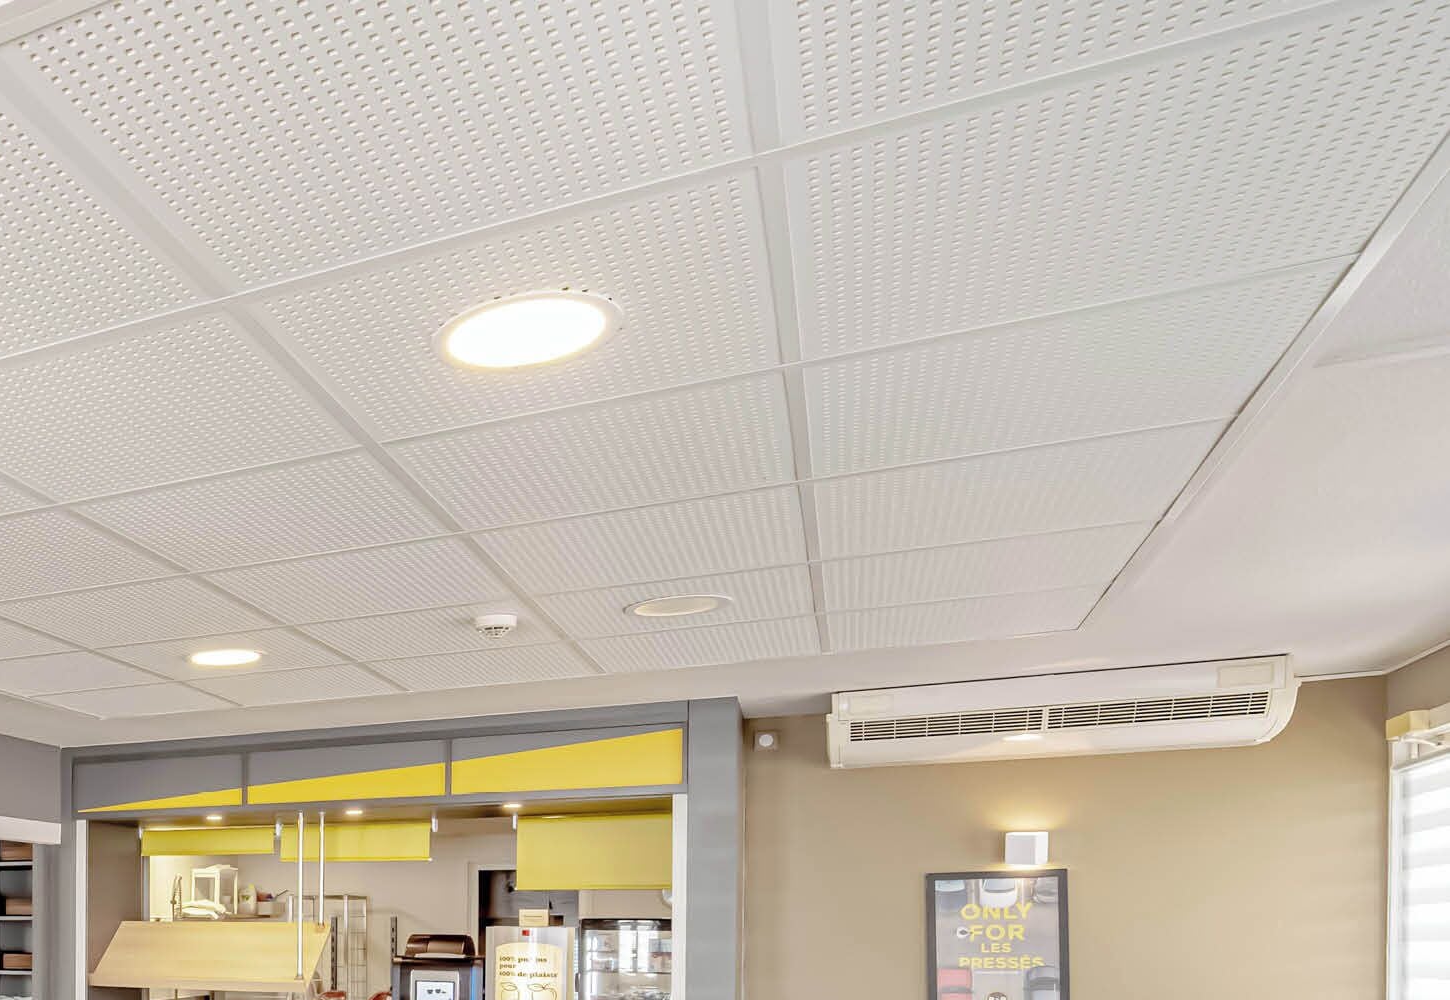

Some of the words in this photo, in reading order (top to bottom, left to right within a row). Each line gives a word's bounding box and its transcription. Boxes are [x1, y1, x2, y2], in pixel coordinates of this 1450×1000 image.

[961, 902, 1032, 920] ONLY
[969, 923, 1025, 941] FOR
[981, 942, 1012, 953] LES
